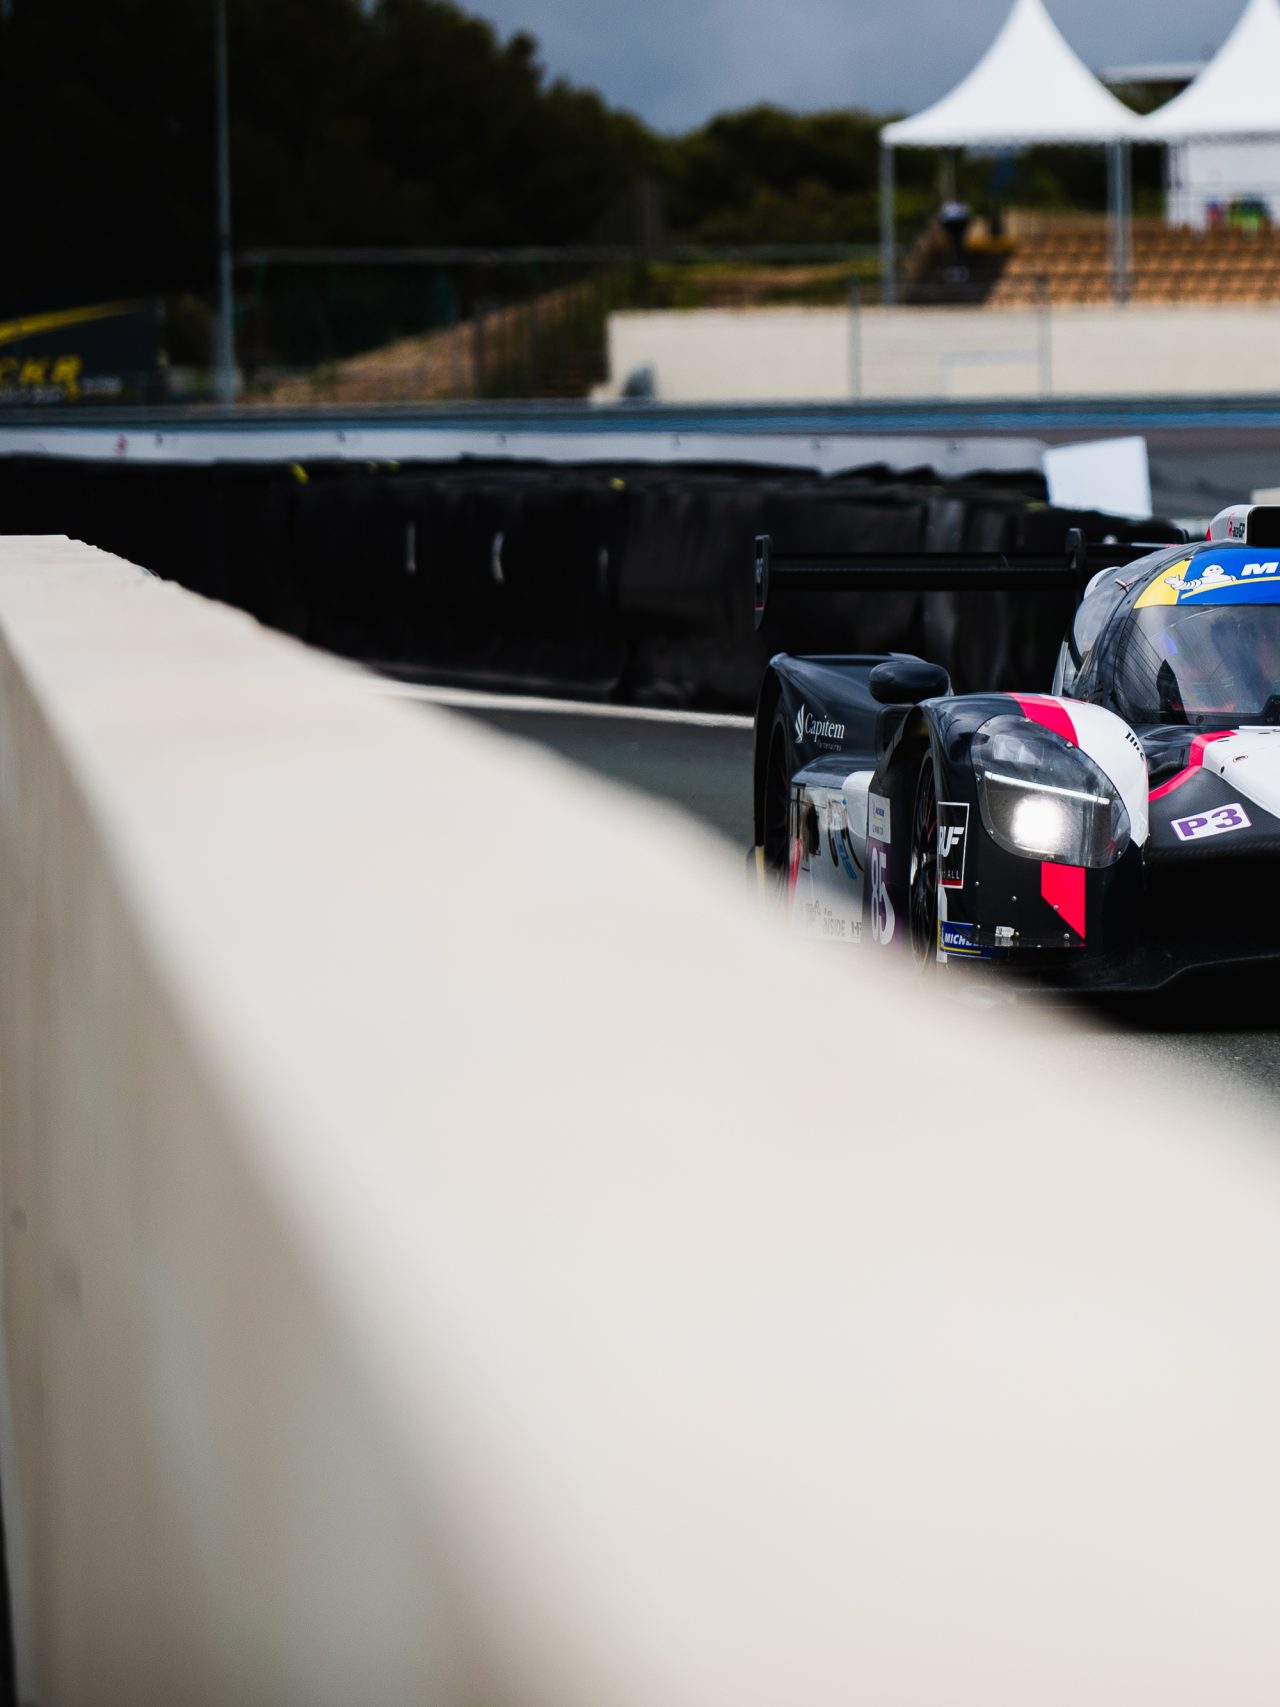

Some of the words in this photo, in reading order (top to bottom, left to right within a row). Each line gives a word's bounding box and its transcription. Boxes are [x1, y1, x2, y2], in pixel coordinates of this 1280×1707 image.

[805, 712, 845, 743] Capitem
[1177, 808, 1243, 837] P3
[871, 847, 896, 945] 85
